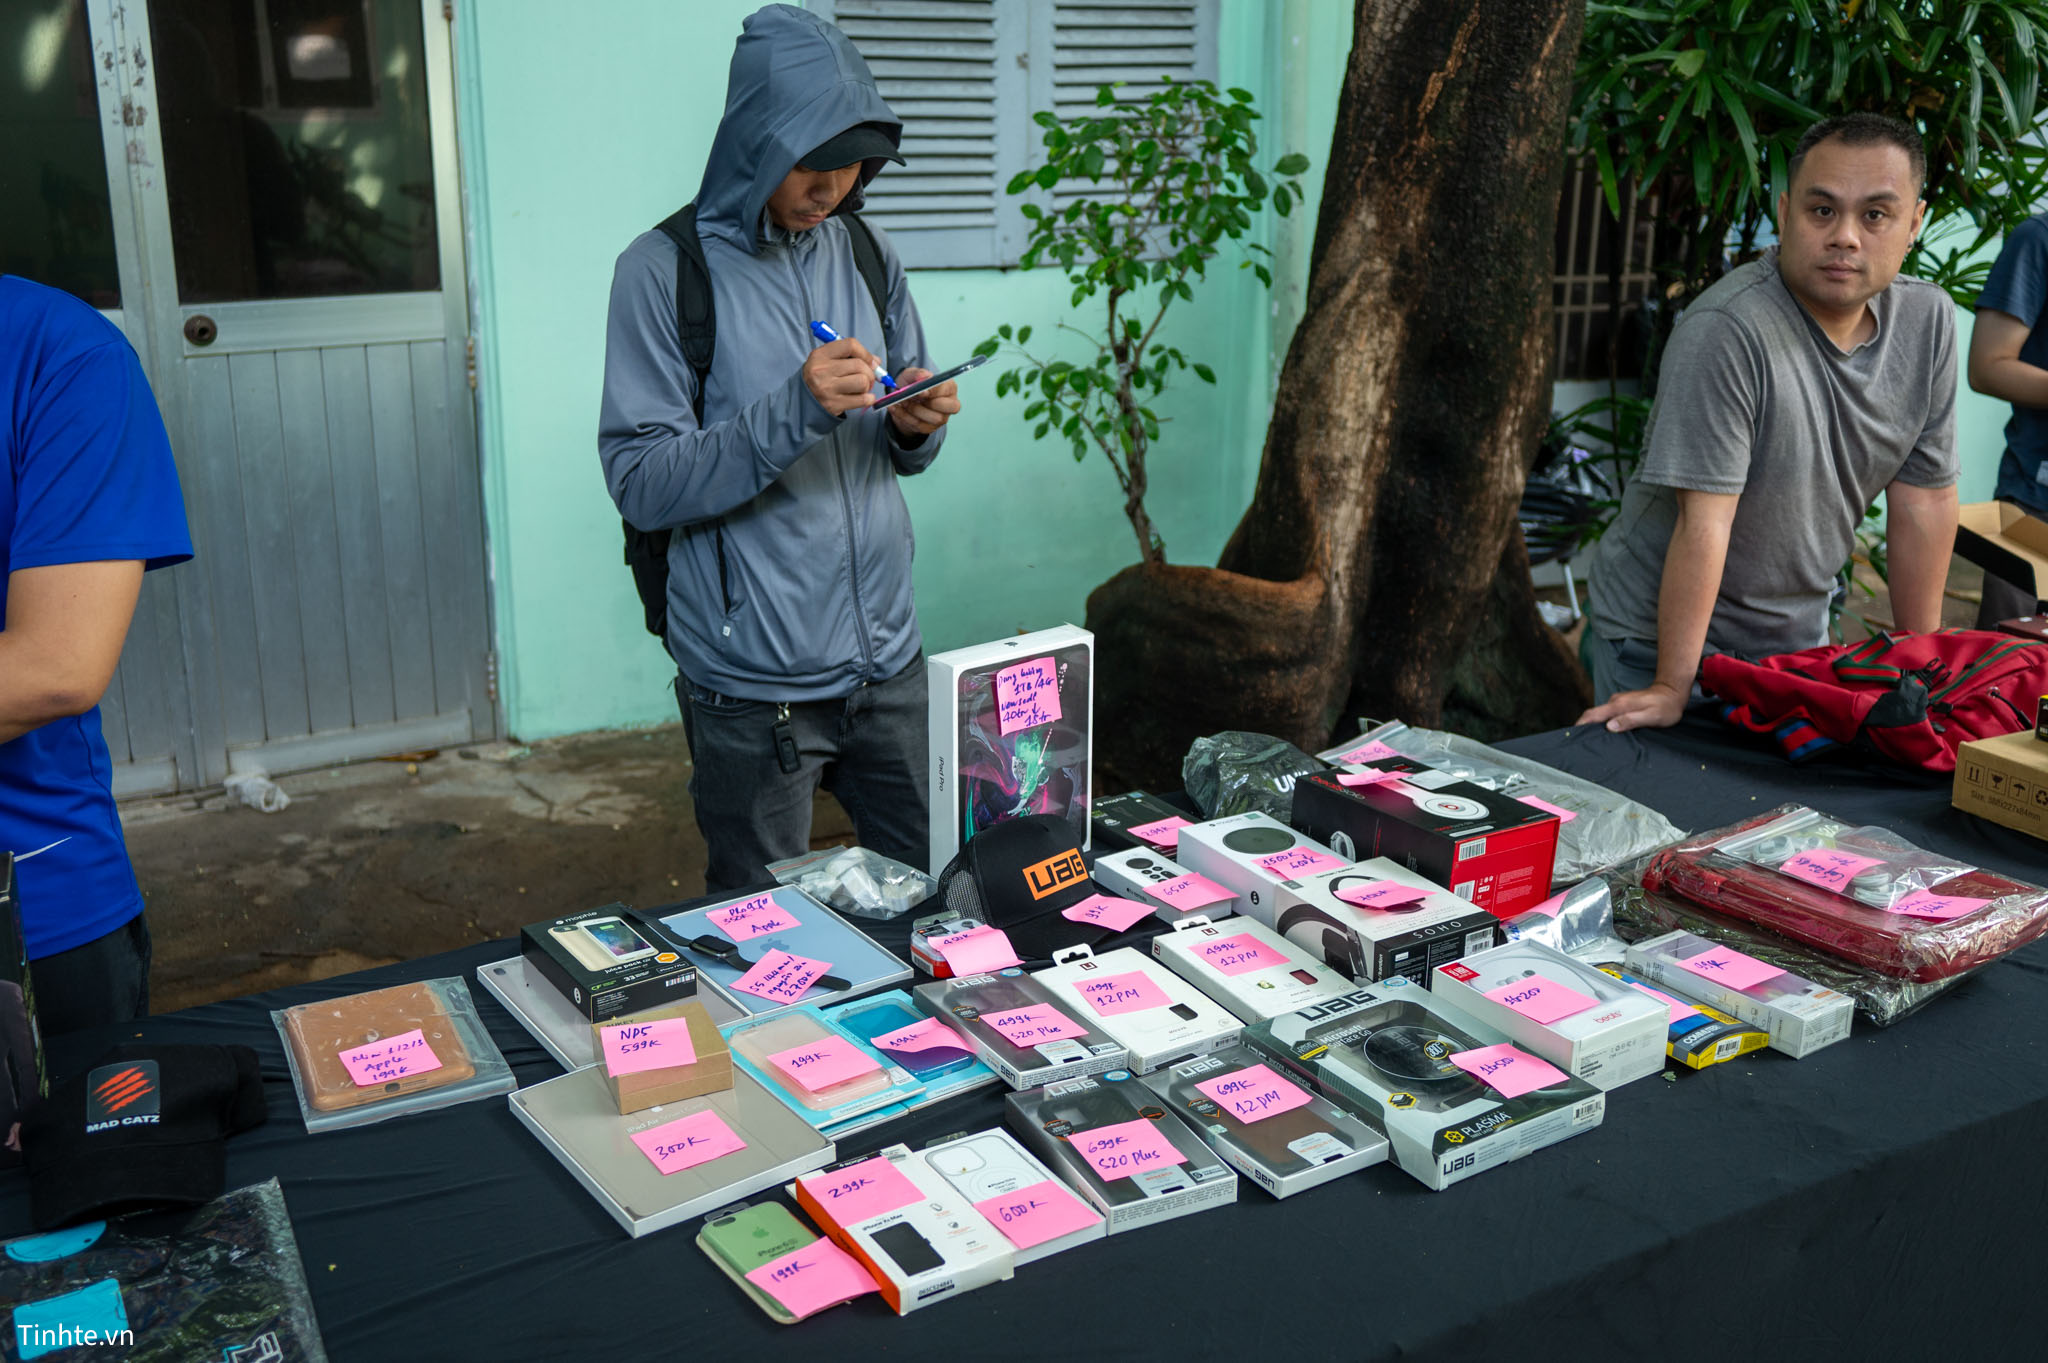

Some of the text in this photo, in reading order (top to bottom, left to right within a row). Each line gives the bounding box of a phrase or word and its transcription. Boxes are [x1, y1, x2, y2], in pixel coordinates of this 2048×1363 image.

[1030, 854, 1085, 894] UAG
[565, 911, 597, 923] mophie
[751, 920, 785, 934] Apple
[1413, 921, 1462, 939] SOHO
[604, 965, 622, 974] juice
[623, 960, 642, 969] pack
[951, 975, 998, 989] UAG
[1295, 990, 1379, 1022] UAG
[1595, 1010, 1621, 1024] beats
[1320, 1025, 1365, 1043] Microsoft
[1328, 1034, 1360, 1048] Surface
[1176, 1057, 1225, 1079] UAG
[1048, 1078, 1100, 1097] UAG
[86, 1113, 160, 1133] MAD CATZ
[1461, 1111, 1512, 1136] PLASMA
[1443, 1153, 1475, 1176] UAG
